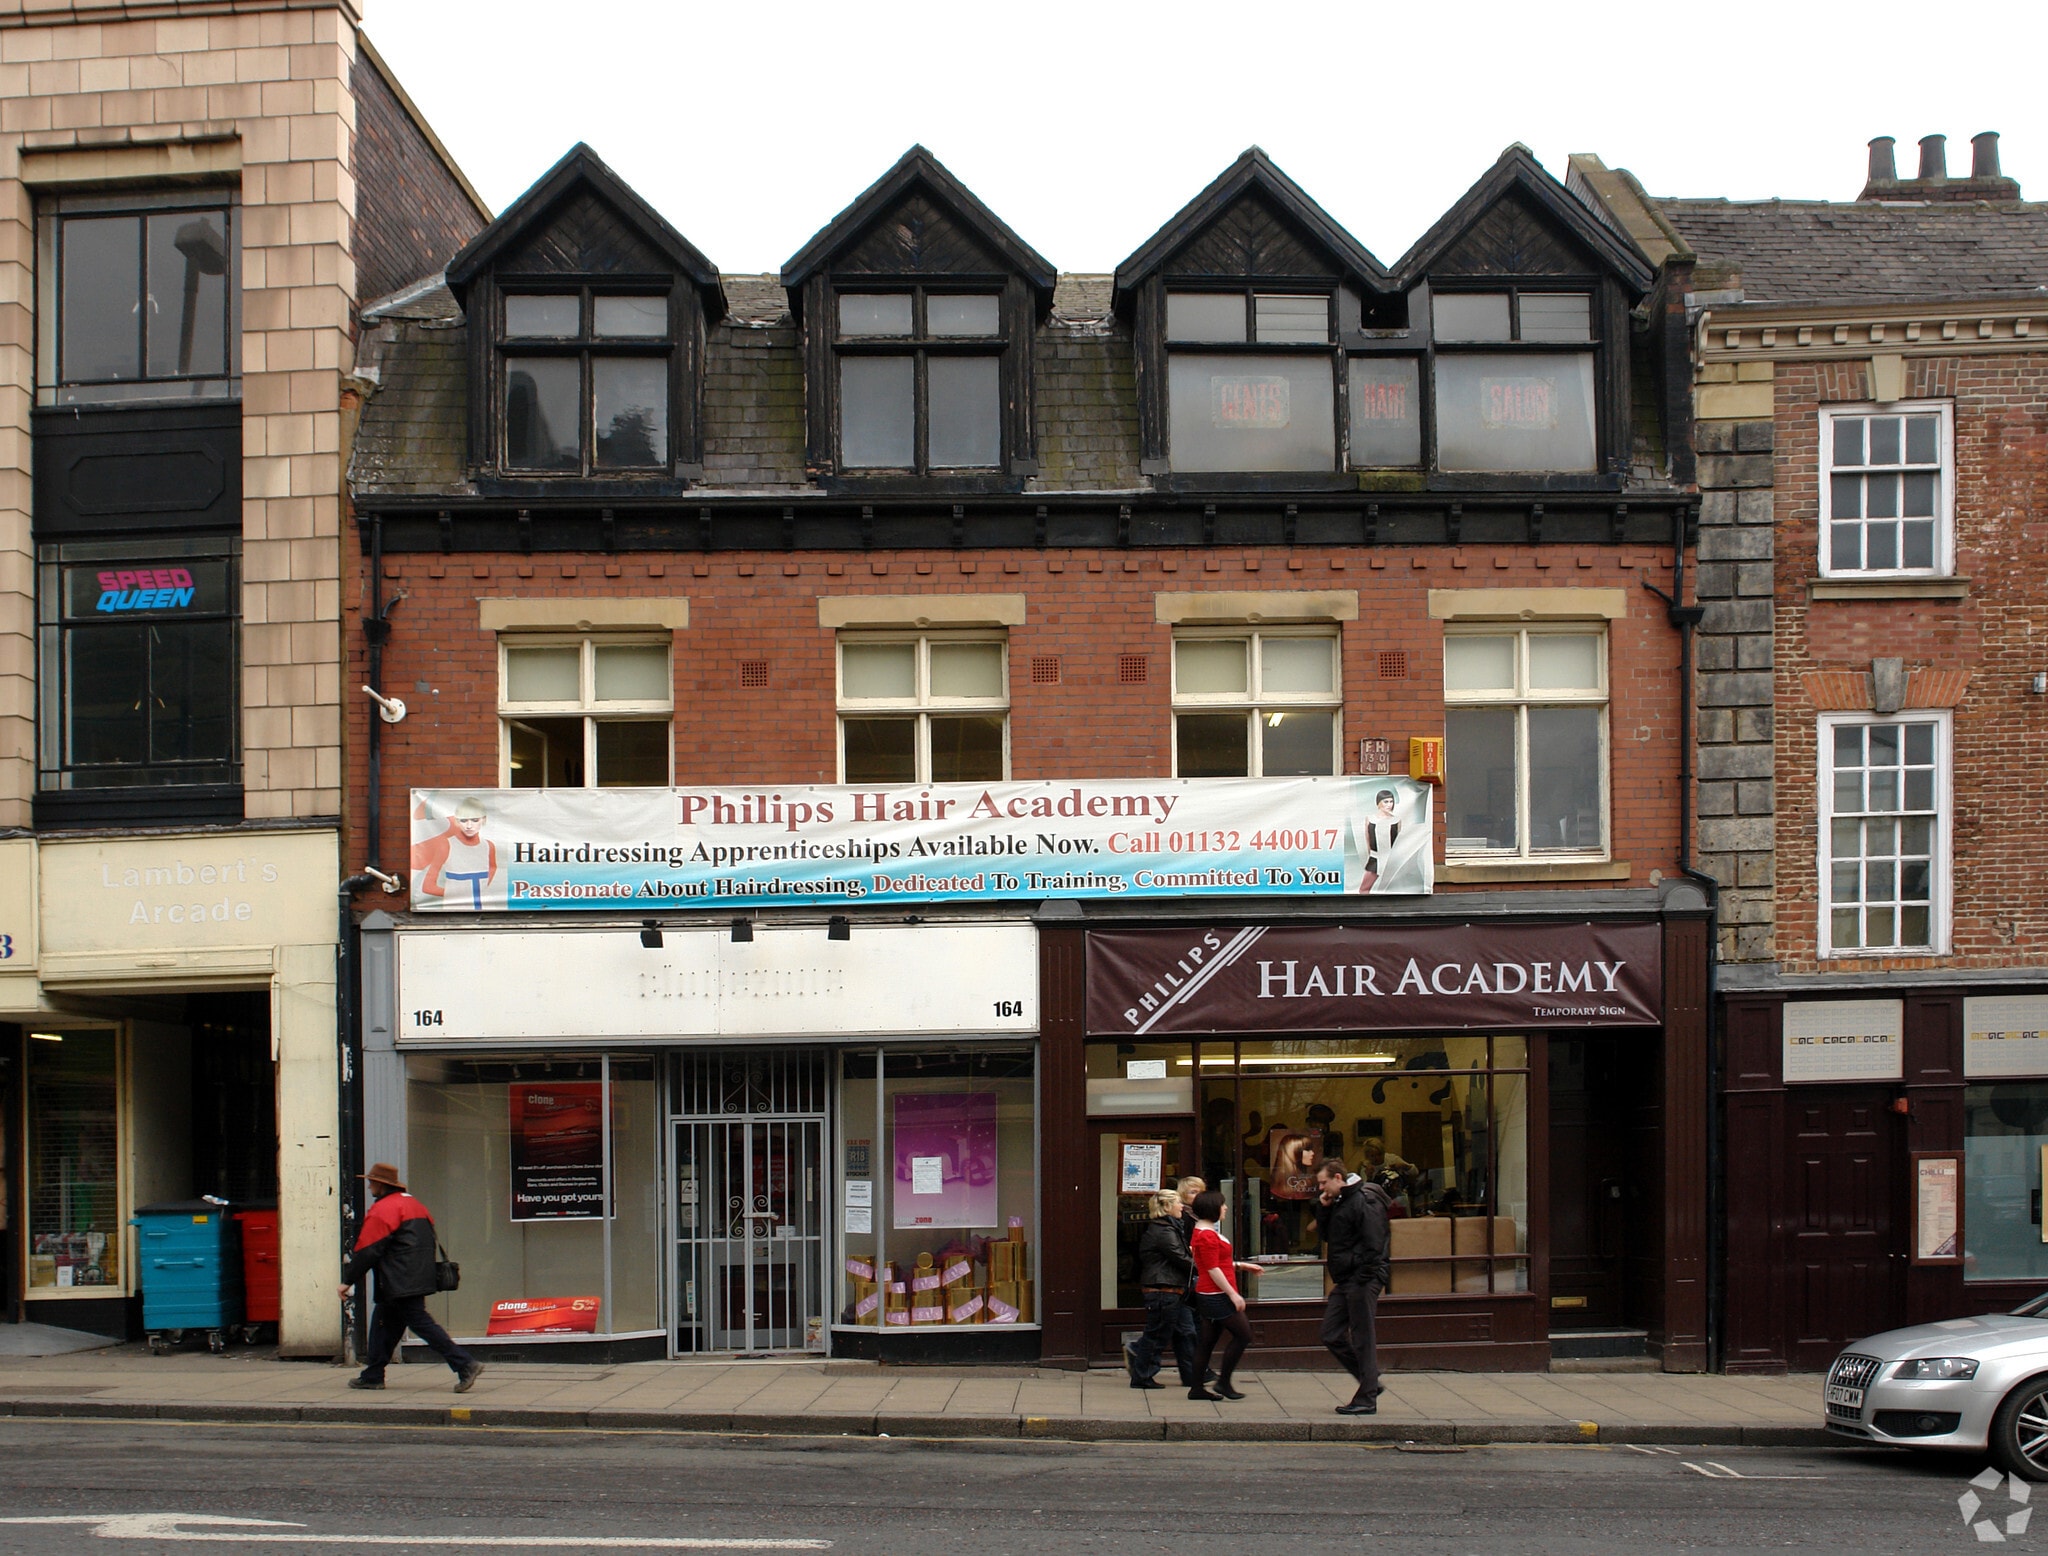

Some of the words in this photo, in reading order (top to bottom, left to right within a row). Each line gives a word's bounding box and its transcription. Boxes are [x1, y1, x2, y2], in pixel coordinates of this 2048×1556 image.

[1221, 383, 1281, 421] GENTS
[1364, 383, 1406, 420] HAIR
[1490, 384, 1549, 422] SALON
[96, 568, 193, 590] SPEED
[95, 587, 196, 613] QUEEN
[678, 794, 834, 832] Philips
[850, 791, 956, 822] Hair
[968, 788, 1179, 824] Academy
[514, 841, 683, 867] Hairdressing
[689, 838, 900, 867] Apprenticeships
[907, 834, 1027, 857] Available
[1035, 833, 1100, 855] Now.
[1108, 831, 1160, 854] Call
[1169, 830, 1241, 853] 01132
[1249, 828, 1338, 851] 440017
[102, 858, 279, 890] Lambert's
[512, 879, 632, 899] Passionate
[637, 878, 707, 897] About
[715, 876, 866, 896] Hairdressing,
[872, 873, 984, 892] Dedicated
[991, 873, 1018, 890] To
[1025, 871, 1127, 891] Training,
[1134, 868, 1258, 887] Committed
[1265, 867, 1292, 885] To
[1300, 867, 1340, 885] You
[129, 896, 253, 926] Arcade
[0, 934, 13, 959] 3
[1122, 930, 1222, 1026] PHILIPS
[1256, 960, 1384, 998] HAIR
[1394, 957, 1625, 996] ACADEMY
[413, 1010, 444, 1028] 164
[993, 1000, 1023, 1018] 164
[1533, 1006, 1596, 1018] TEMPORARY
[1599, 1004, 1626, 1016] SIGN
[517, 1193, 542, 1203] Have
[542, 1194, 560, 1205] you
[561, 1193, 577, 1204] got
